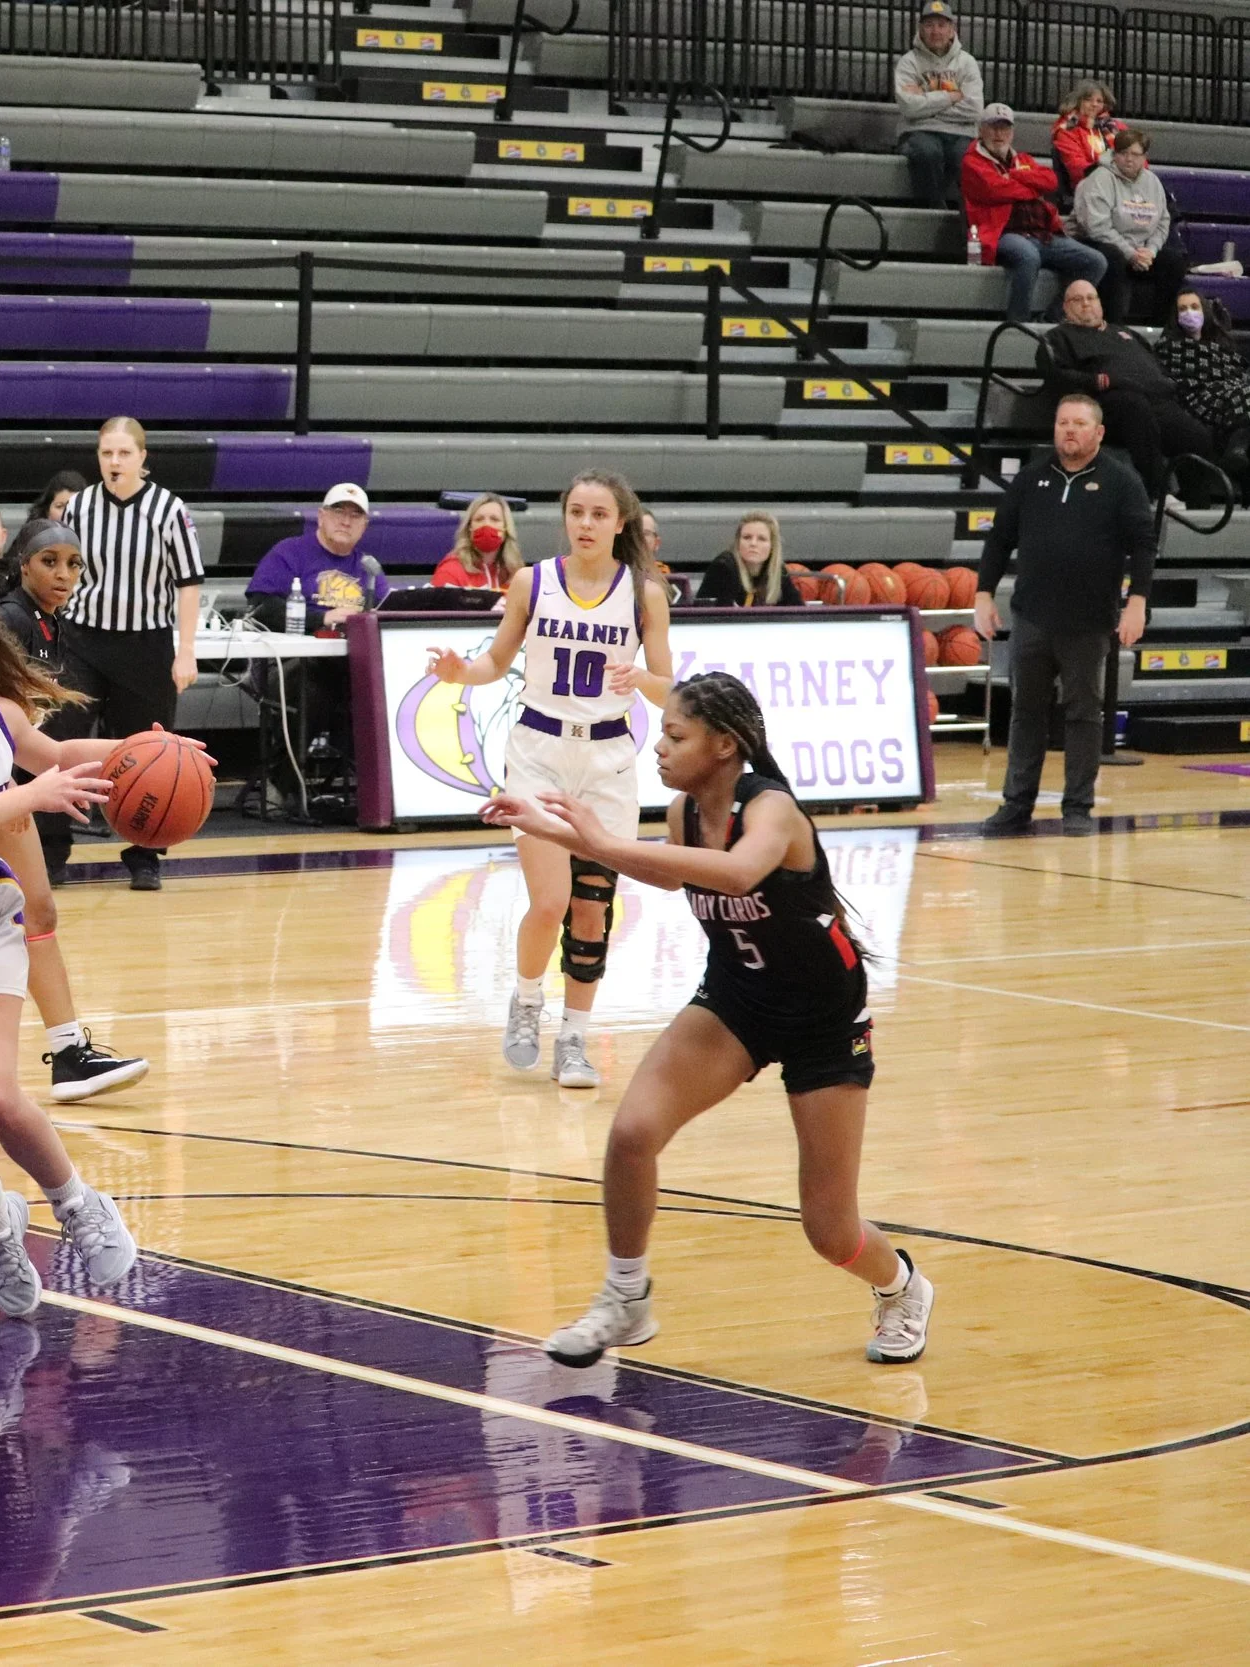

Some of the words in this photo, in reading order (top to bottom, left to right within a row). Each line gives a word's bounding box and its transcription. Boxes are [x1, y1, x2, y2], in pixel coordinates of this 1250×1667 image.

[537, 617, 629, 646] KEARNEY
[552, 647, 607, 697] 10
[674, 651, 895, 707] ARNEY
[791, 738, 905, 787] DOGS
[718, 892, 772, 922] CARDS
[728, 928, 765, 969] 5
